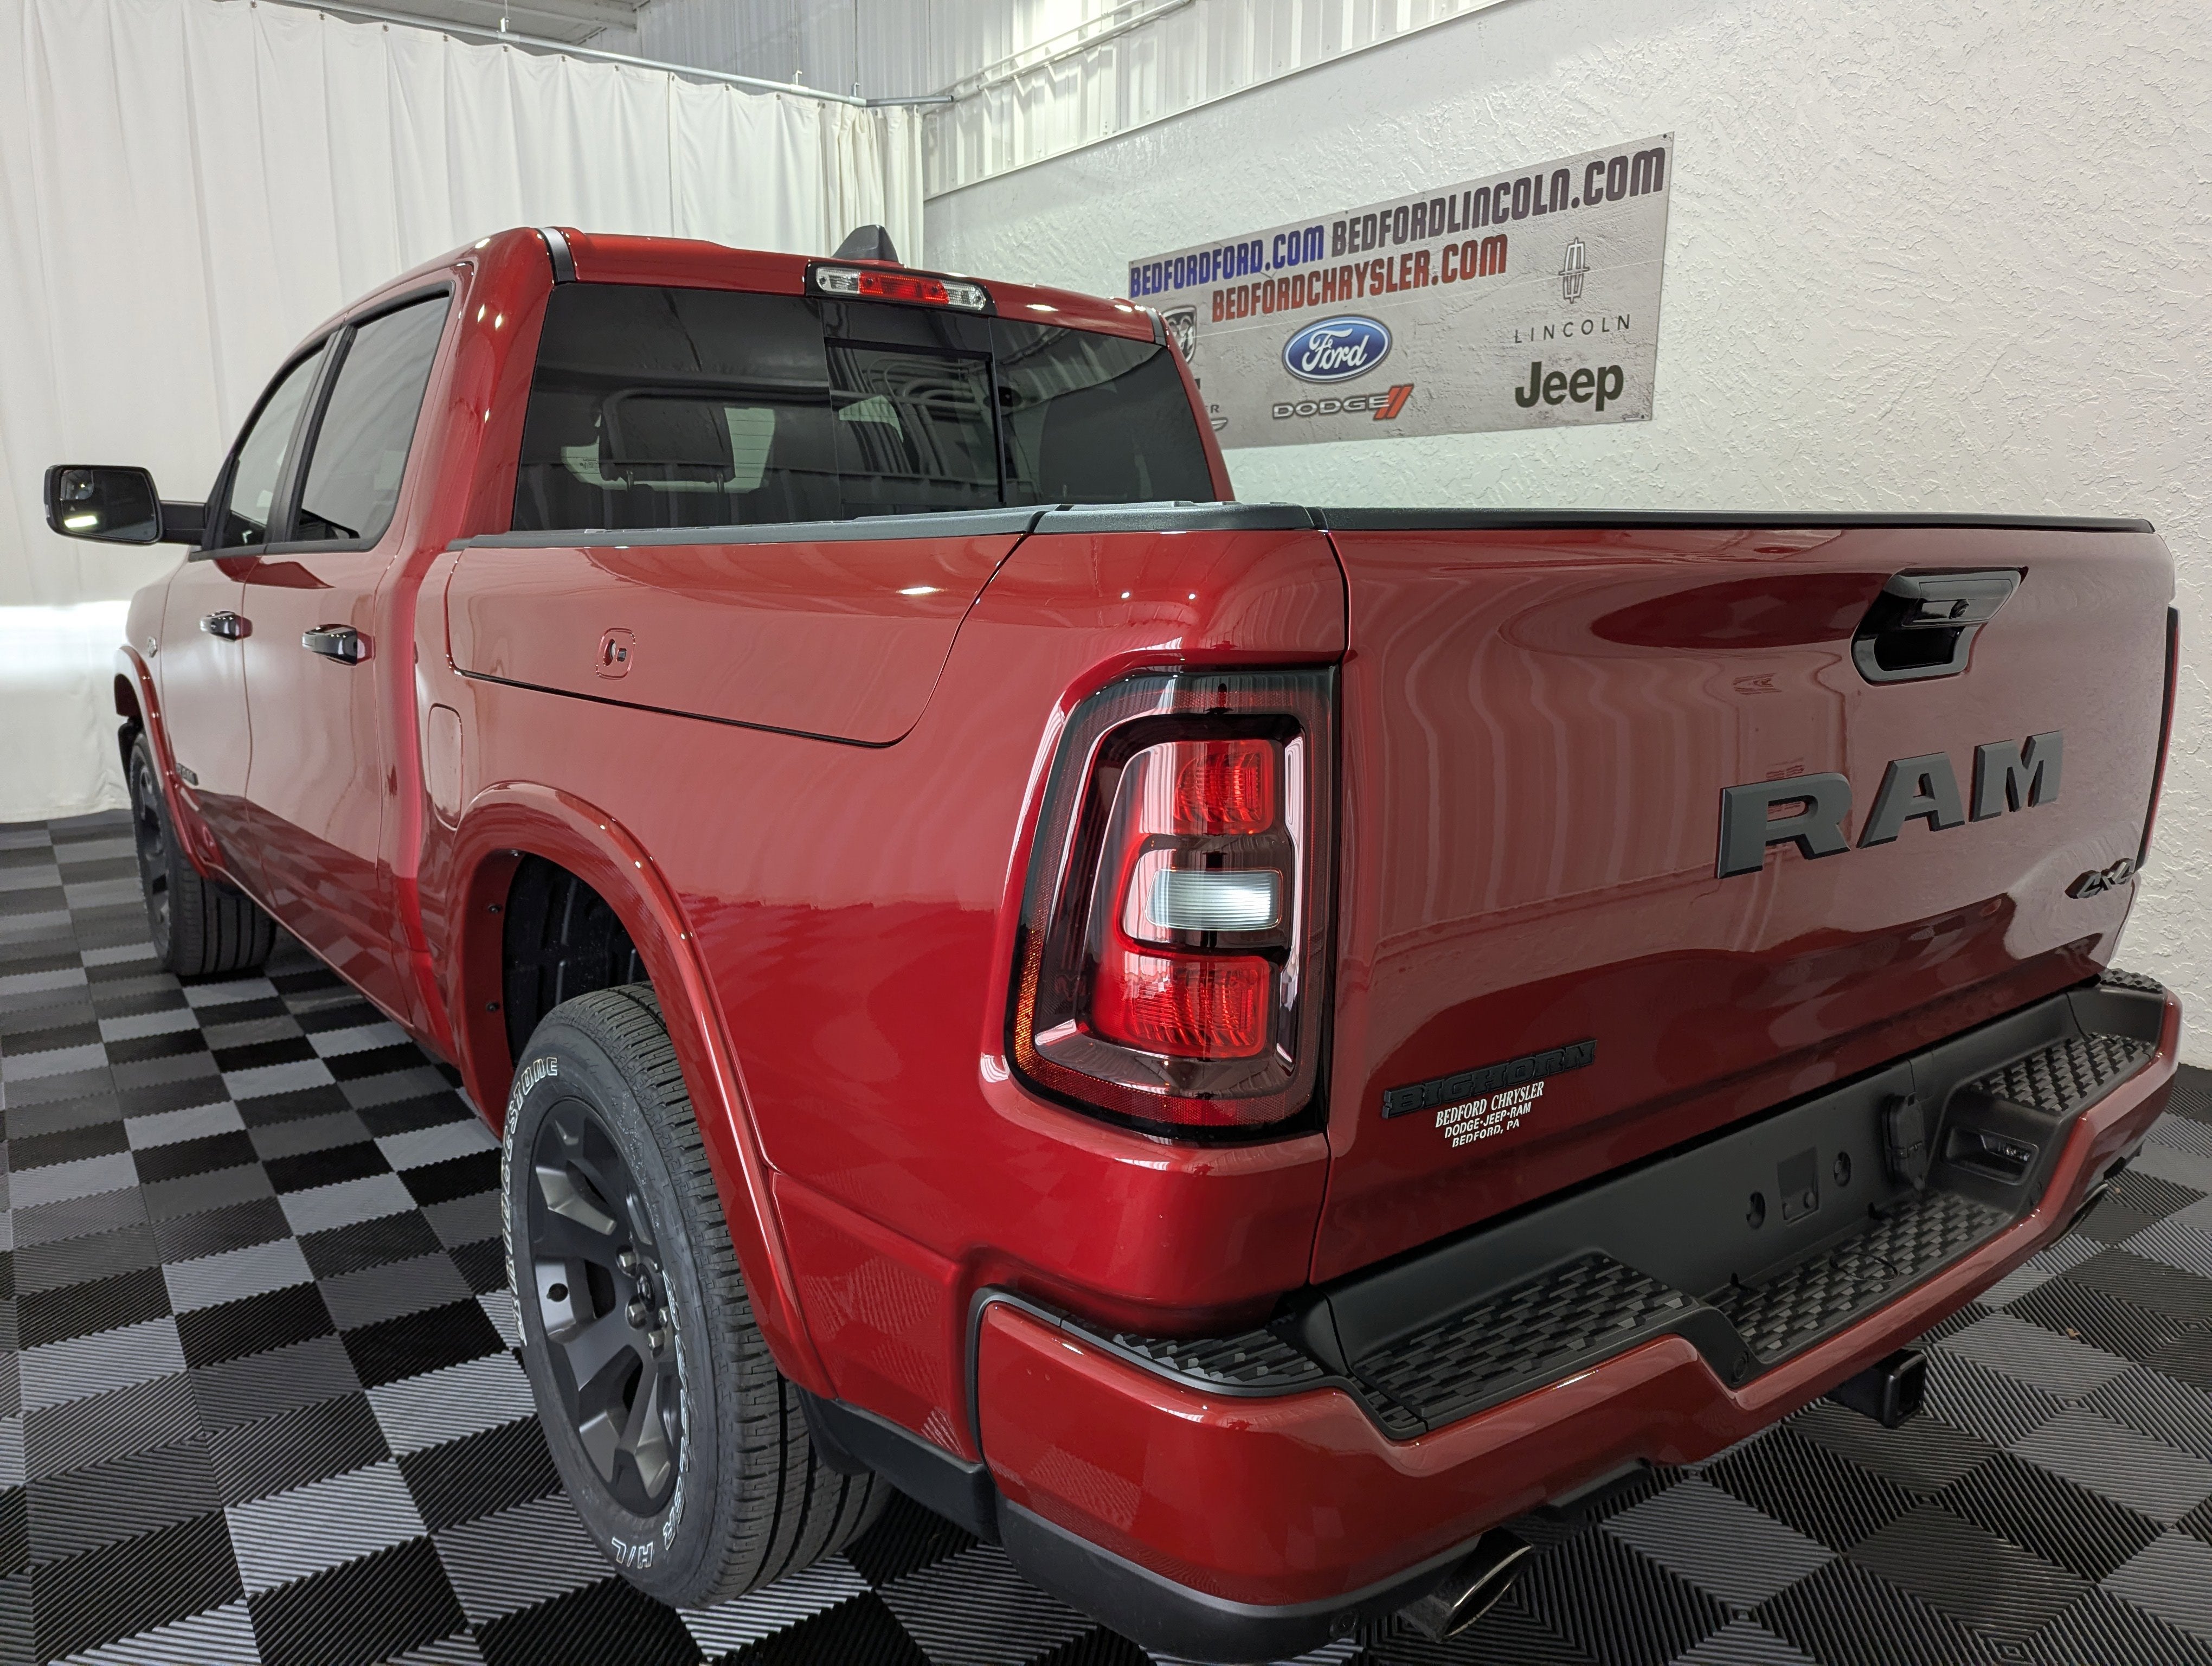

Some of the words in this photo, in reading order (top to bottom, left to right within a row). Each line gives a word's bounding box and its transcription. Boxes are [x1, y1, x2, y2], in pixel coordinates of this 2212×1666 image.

[1130, 225, 1324, 298] BEDFORDFORD.COM
[1332, 147, 1666, 258] BEDFORDLINCOLN.COM
[1212, 234, 1507, 323] BEDFORDCHRYSLER.COM
[1302, 328, 1370, 371] Ford
[1515, 314, 1630, 343] LINCOLN
[1272, 393, 1390, 420] DODGE
[1515, 361, 1624, 412] Jeep
[1716, 730, 2061, 879] RAM
[1435, 1099, 1487, 1128] BEDFORD
[1491, 1081, 1545, 1111] CHRYSLER
[1452, 1123, 1504, 1148] BEDFORD,
[1506, 1118, 1520, 1131] PA
[501, 1057, 558, 1347] BRIDGESTONE
[612, 1536, 654, 1570] H/L
